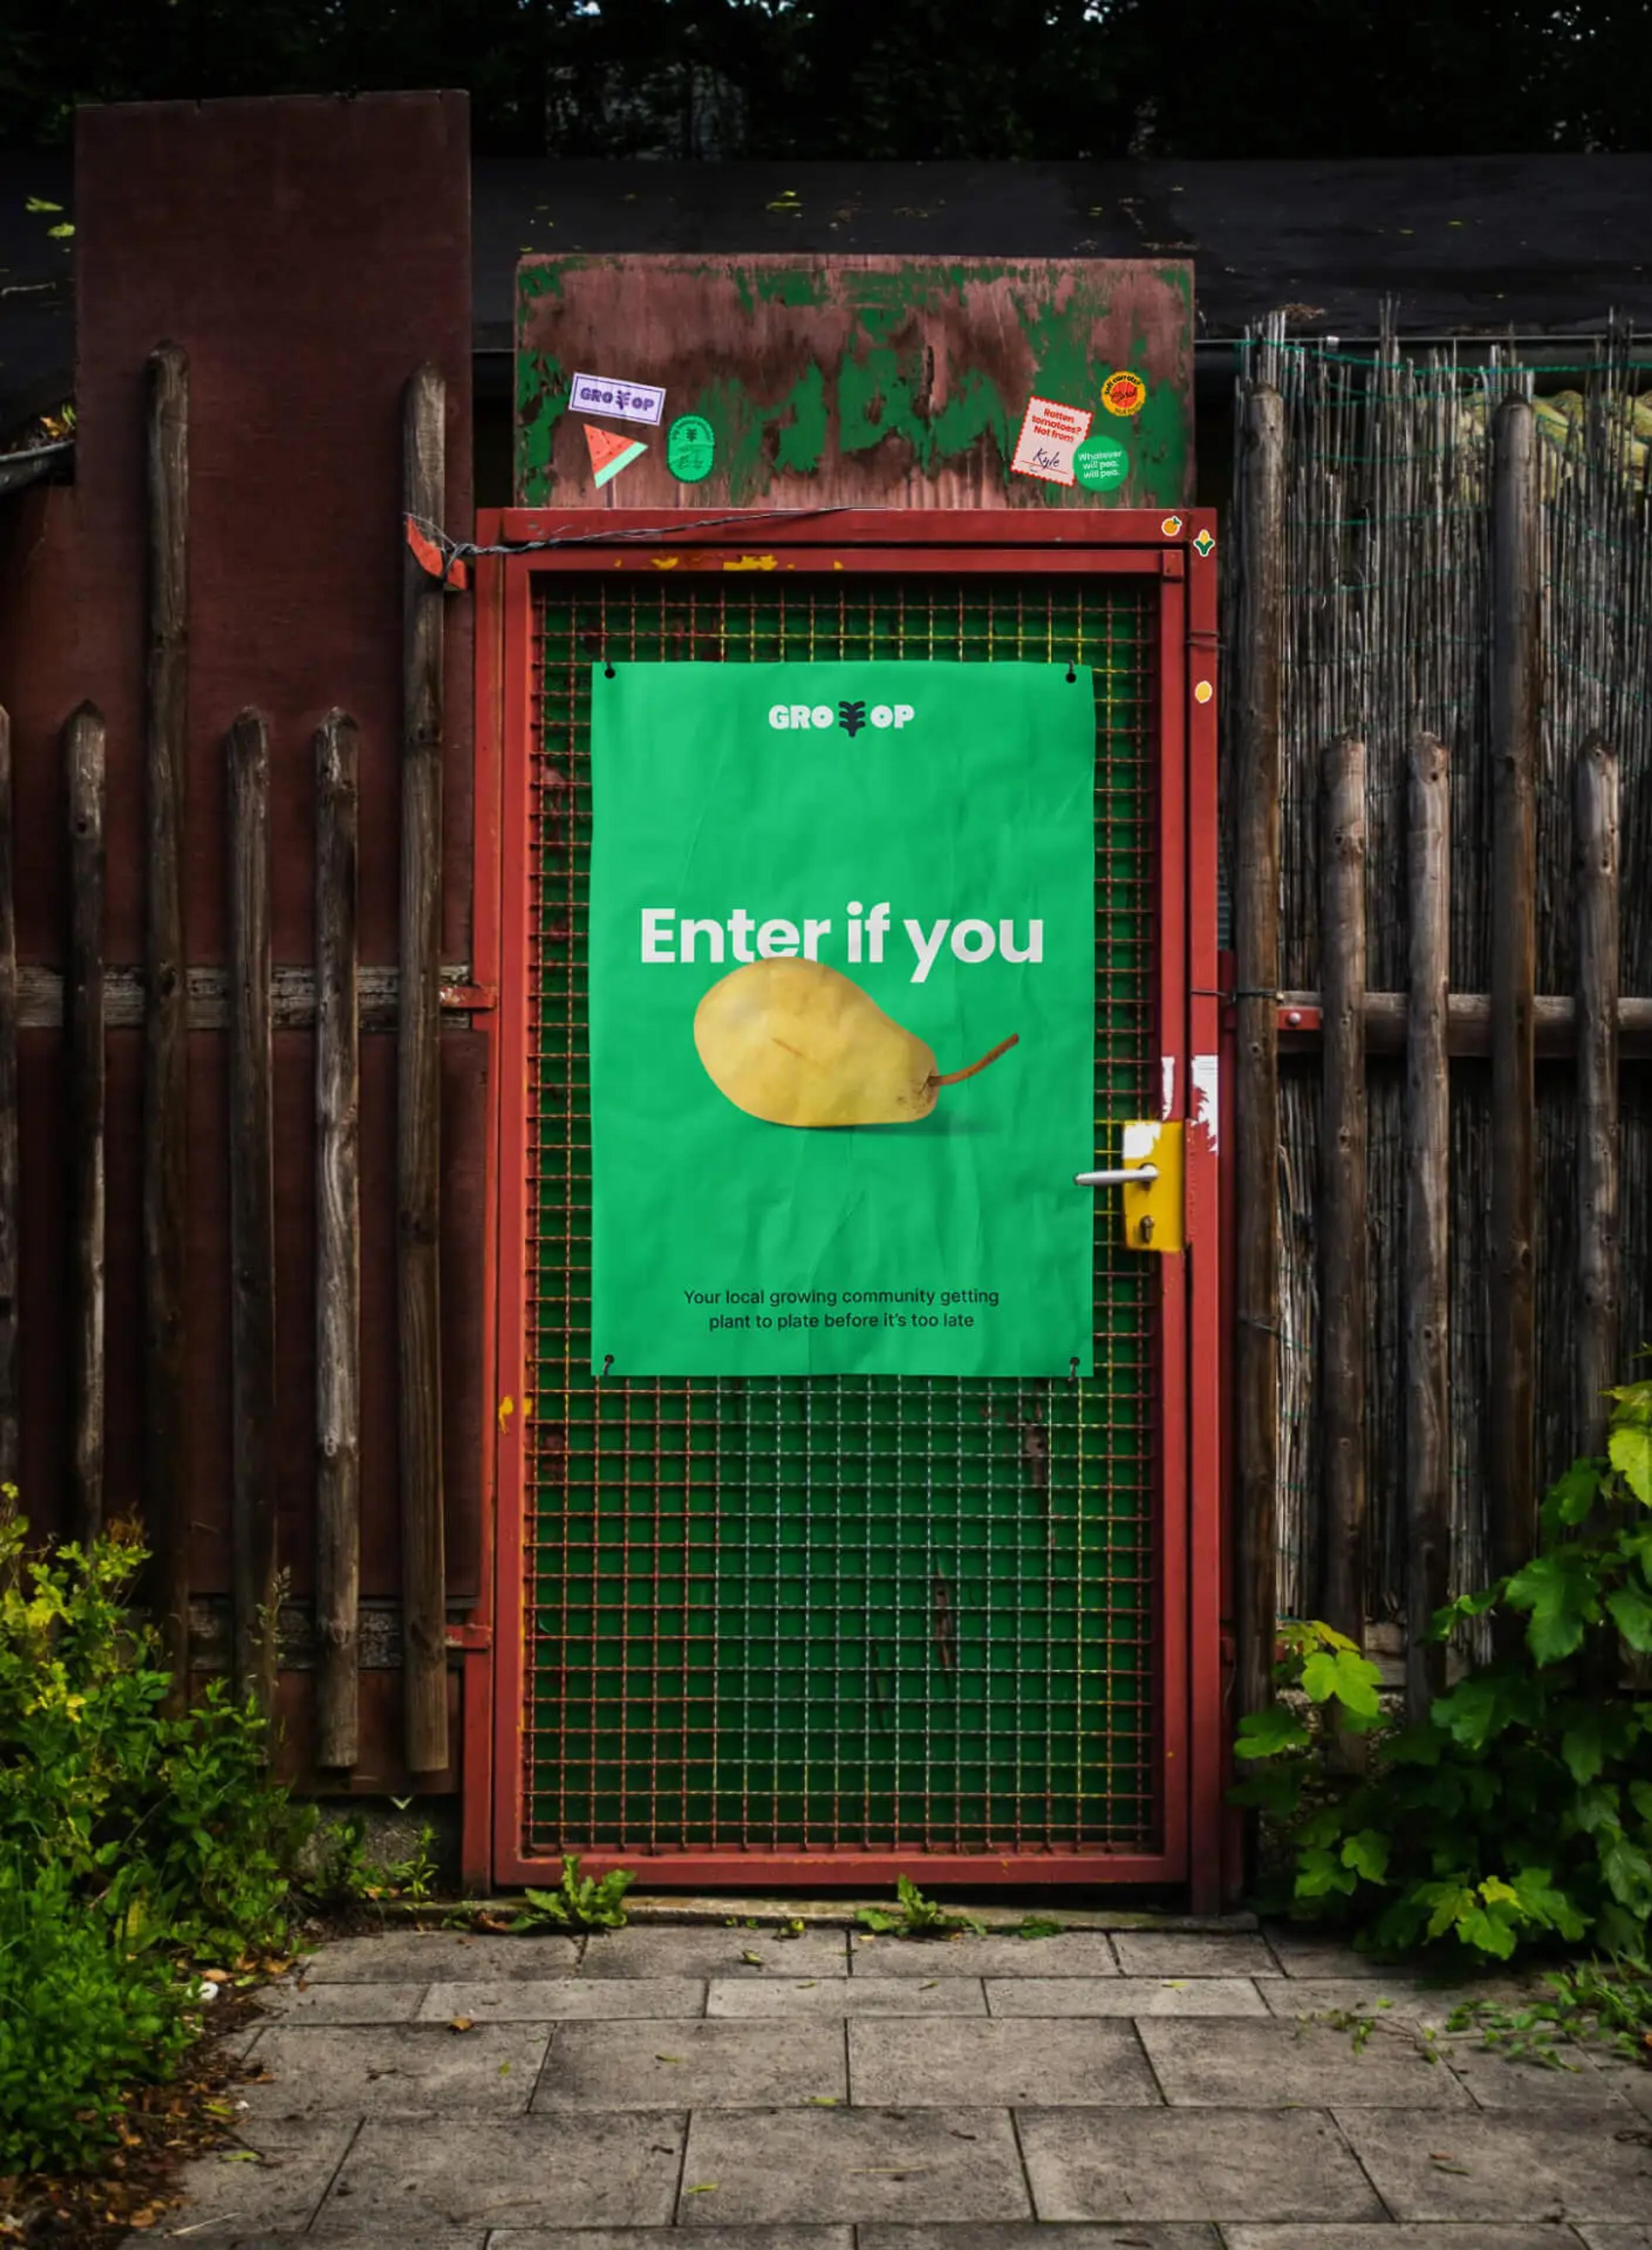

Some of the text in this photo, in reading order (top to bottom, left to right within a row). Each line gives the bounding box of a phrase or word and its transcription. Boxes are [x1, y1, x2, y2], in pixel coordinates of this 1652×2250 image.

[1043, 408, 1074, 423] Rotten
[1032, 416, 1082, 435] tomatoes?
[1033, 426, 1074, 443] Not from
[1032, 448, 1060, 469] Kyle
[1078, 451, 1122, 461] Whatever
[1082, 460, 1098, 469] will
[1083, 470, 1099, 478] will
[641, 901, 1044, 983] Enter if you
[684, 1289, 999, 1307] Your local growing community getting
[709, 1312, 975, 1331] plant to plate before it's too late
